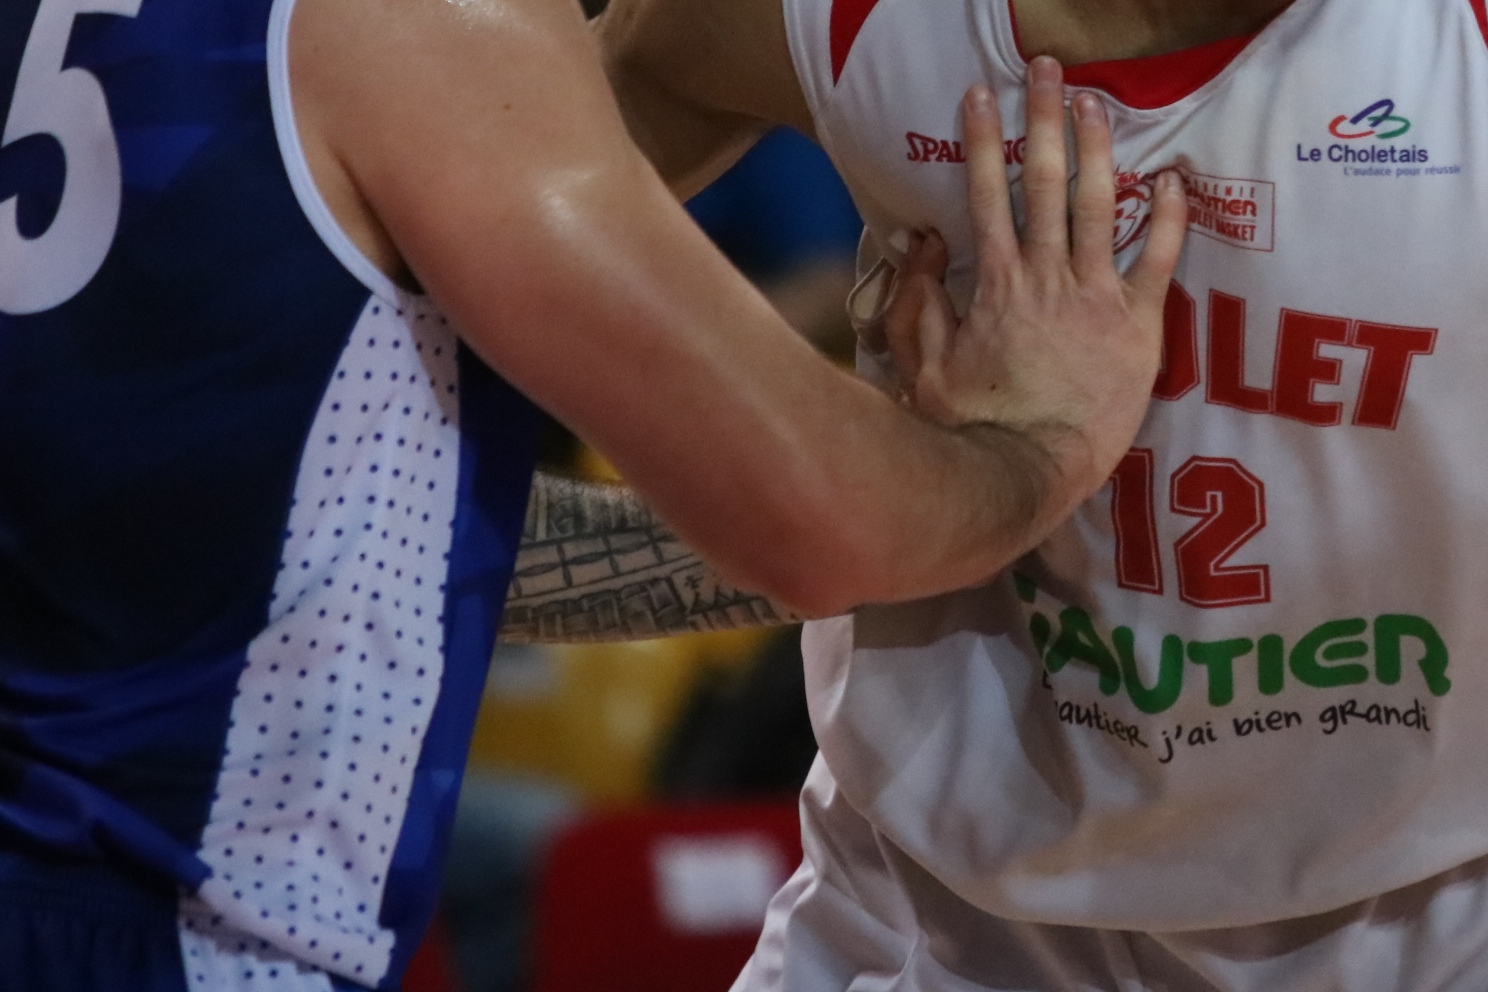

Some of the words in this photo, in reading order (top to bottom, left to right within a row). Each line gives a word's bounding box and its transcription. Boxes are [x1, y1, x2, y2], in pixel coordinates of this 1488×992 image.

[905, 131, 1028, 166] SPALNG
[1296, 143, 1322, 162] Le
[1327, 144, 1429, 163] Choletais
[1396, 167, 1420, 178] pour
[1151, 278, 1440, 430] OLET
[1107, 446, 1272, 610] 12
[1054, 700, 1149, 749] autier
[1157, 721, 1218, 764] j'ai
[1233, 710, 1303, 738] bien
[1318, 698, 1431, 734] grandi
